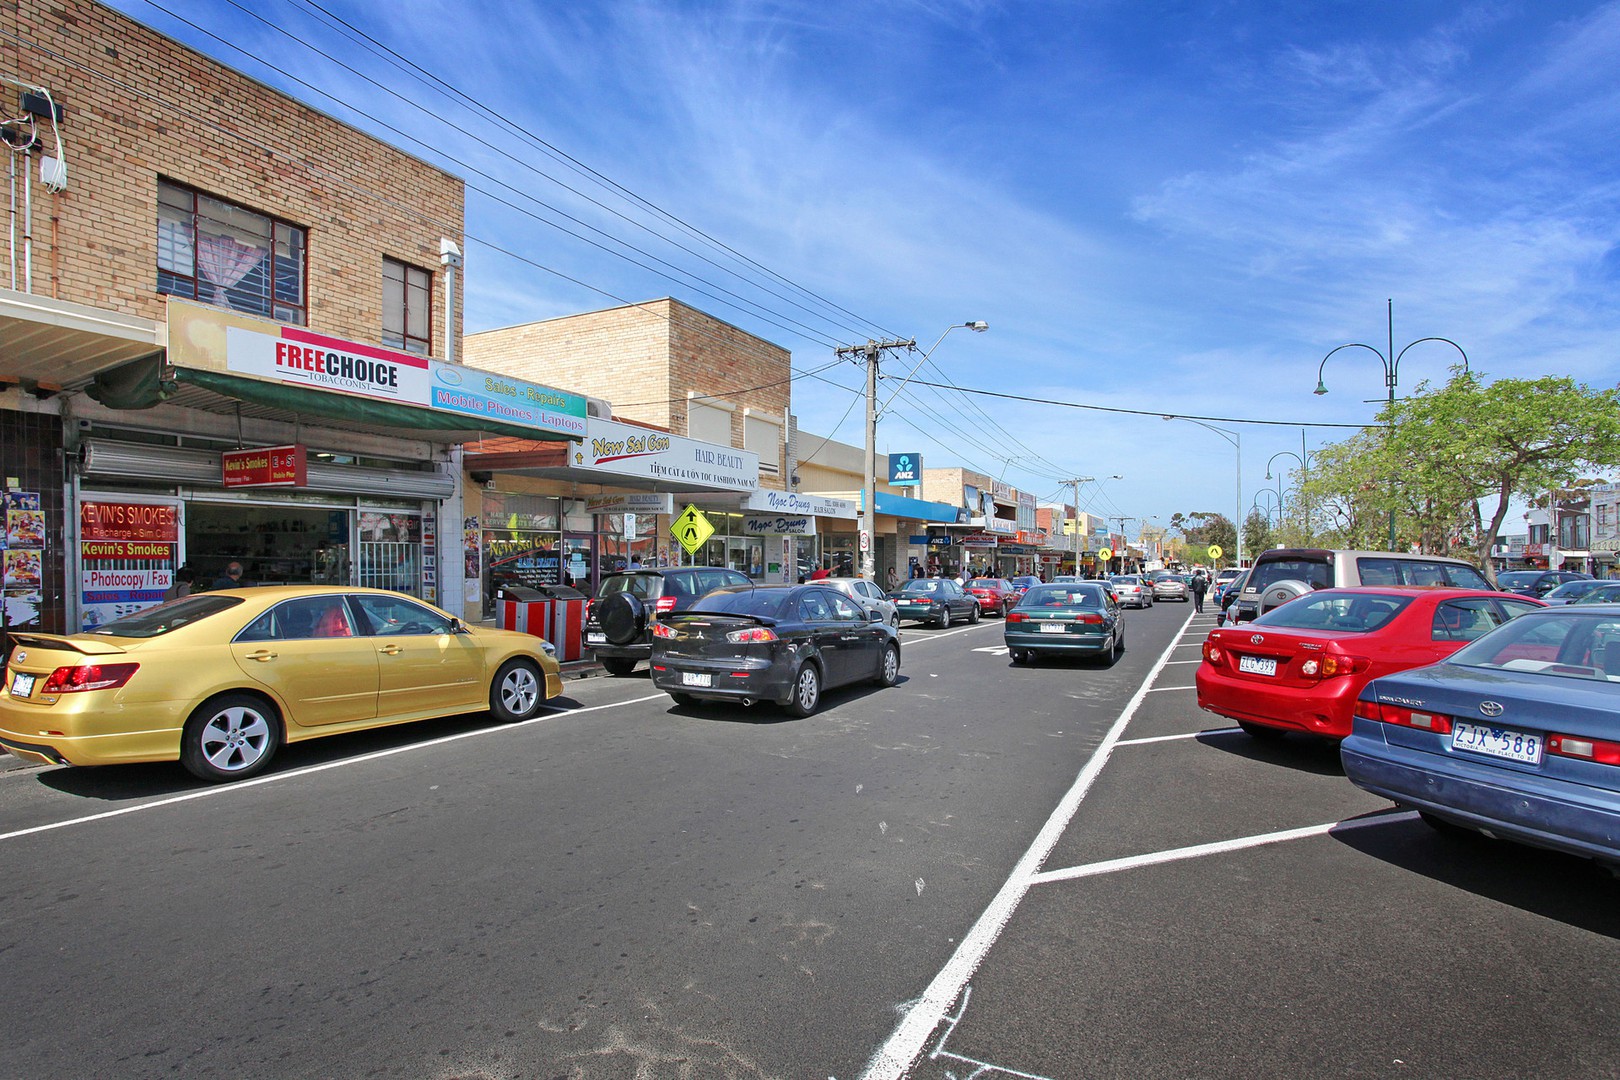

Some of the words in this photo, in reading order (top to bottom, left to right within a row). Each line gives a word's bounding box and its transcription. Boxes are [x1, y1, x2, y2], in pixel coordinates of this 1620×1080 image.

[275, 341, 398, 387] FREECHOICE
[307, 371, 373, 391] TOBACCONIST
[484, 377, 517, 397] Sales
[526, 387, 566, 408] Repairs
[437, 390, 483, 411] Mobile
[487, 400, 533, 421] Phones
[541, 412, 584, 431] Laptops
[592, 437, 624, 457] New
[626, 435, 646, 454] Sai
[647, 433, 670, 451] Gon
[225, 458, 245, 472] Kevin's
[245, 456, 268, 470] Smokes
[272, 455, 279, 468] E
[695, 448, 715, 465] HAIR
[717, 452, 744, 470] BEAUTY
[894, 471, 914, 479] ANZ
[80, 504, 125, 524] KEVIN'S
[127, 506, 175, 526] SMOKES
[93, 527, 132, 539] Recharge
[139, 528, 153, 538] Sim
[82, 542, 124, 555] Kevin's
[127, 543, 170, 556] Smokes
[91, 571, 145, 589] Photocopy
[152, 570, 169, 586] Fax
[86, 591, 119, 602] Sales
[1241, 657, 1255, 669] ZLG
[1259, 659, 1275, 671] 399
[1455, 725, 1489, 747] ZJX
[1501, 733, 1536, 756] 588
[1455, 742, 1479, 750] VICTORIA
[1498, 750, 1514, 758] PLACE
